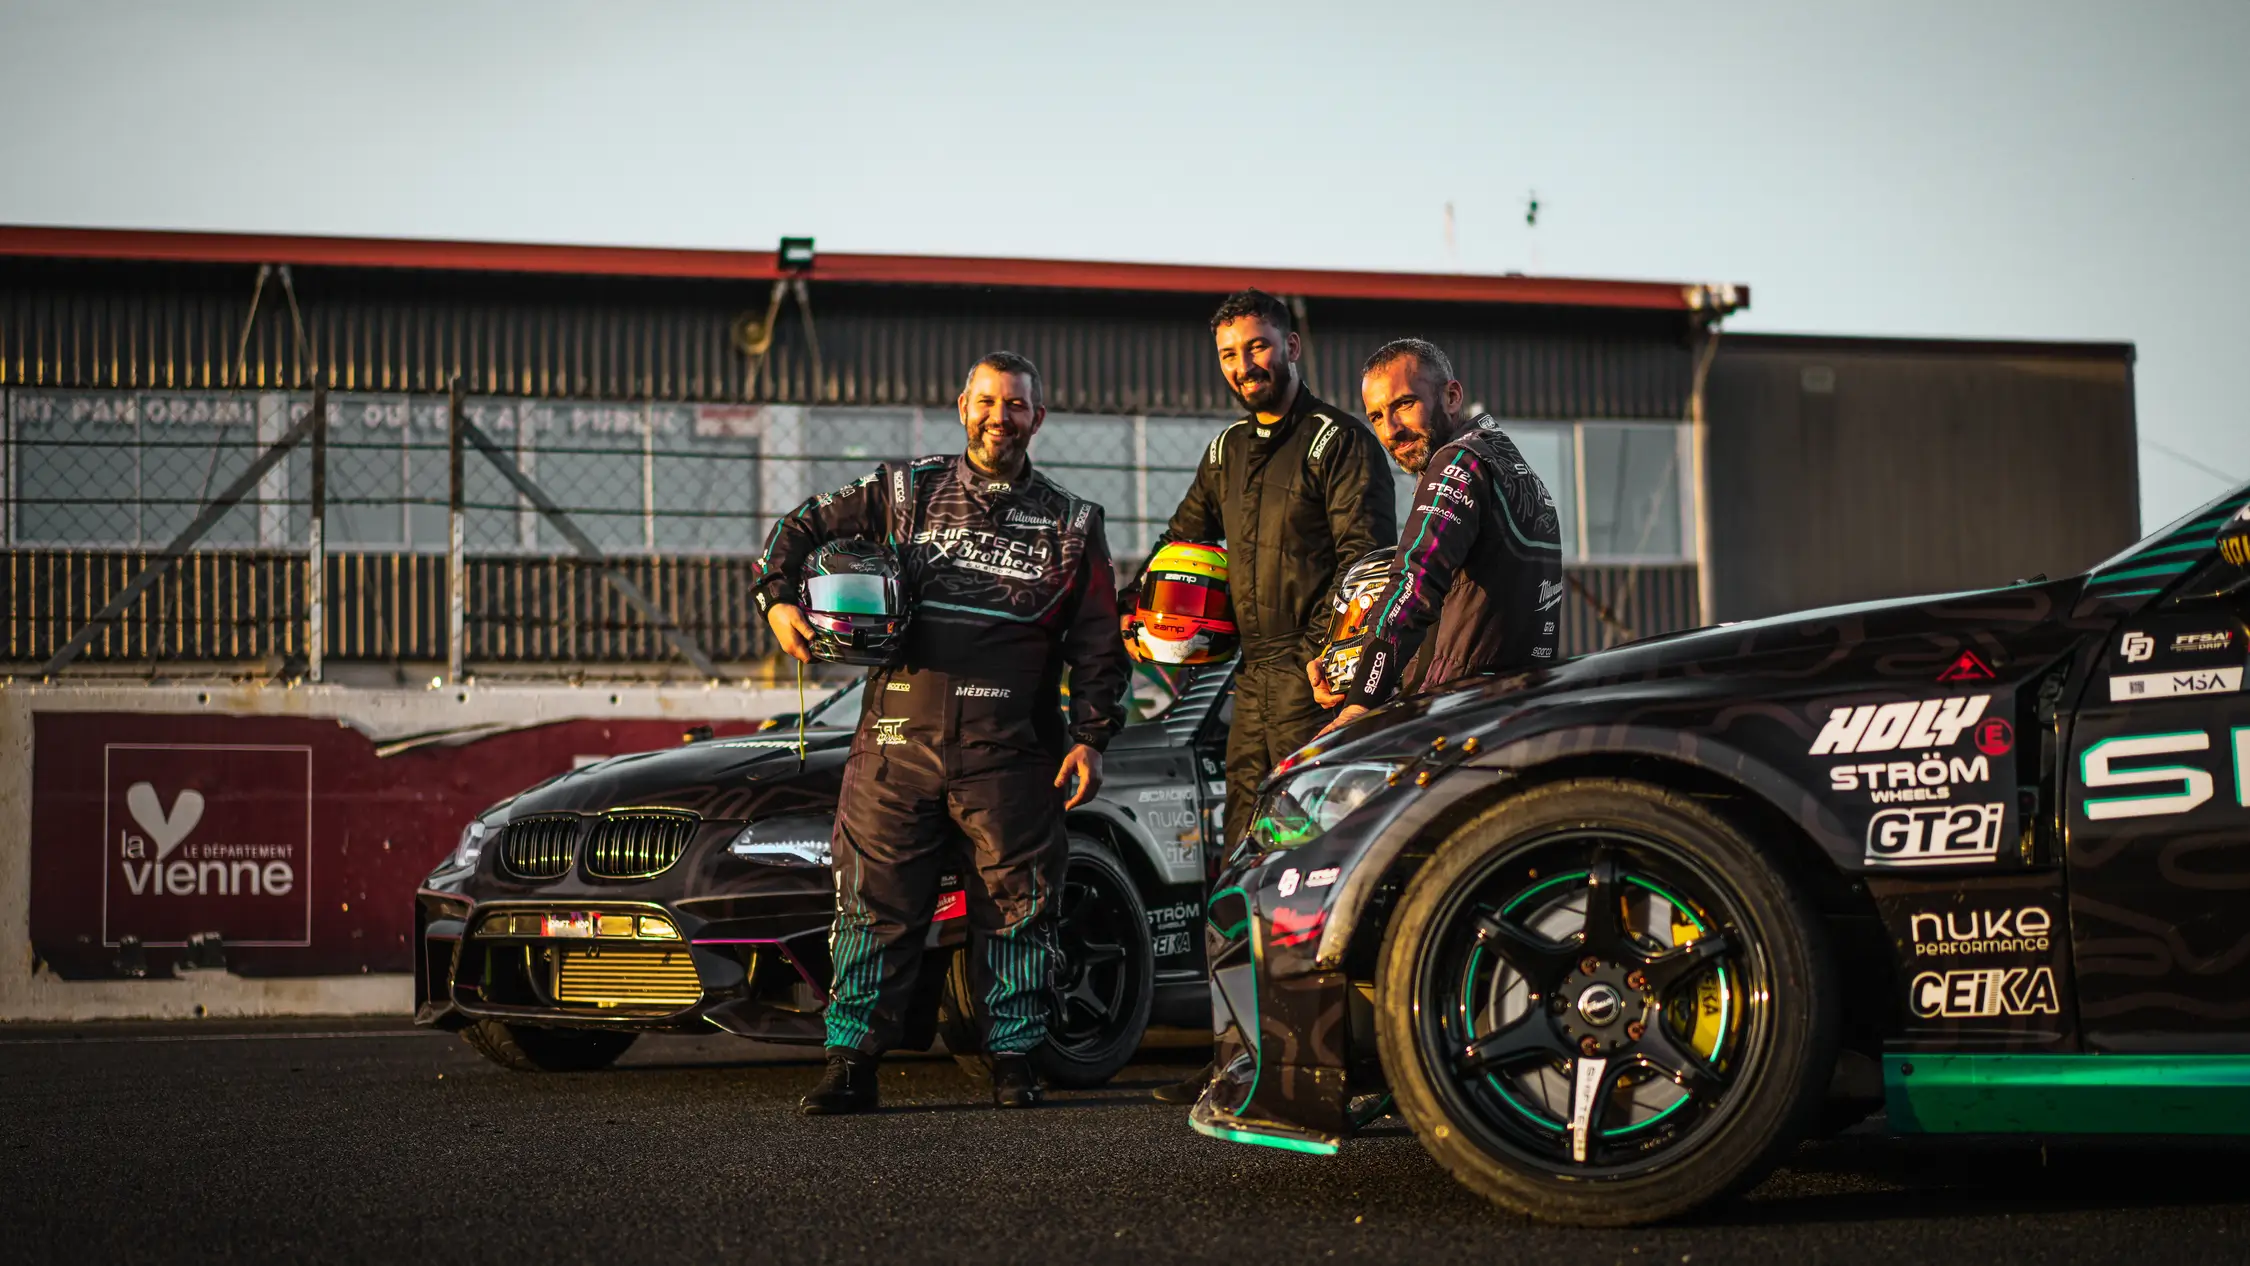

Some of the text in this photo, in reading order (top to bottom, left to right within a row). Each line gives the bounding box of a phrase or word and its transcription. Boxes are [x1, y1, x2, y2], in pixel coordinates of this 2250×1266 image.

[1312, 425, 1339, 460] sparco
[893, 470, 906, 503] sparco
[1074, 503, 1092, 530] sparco
[955, 539, 1044, 580] Brothers
[1164, 572, 1197, 584] zamp
[1154, 623, 1186, 634] zamp
[1364, 651, 1386, 696] sparco
[1808, 694, 1992, 756] HOLY
[1829, 751, 1989, 791] STRÖM
[1871, 786, 1950, 804] WHEELS
[1149, 808, 1197, 828] nuke
[1866, 802, 2004, 857] GT2i
[121, 828, 146, 858] la
[184, 842, 293, 858] LE DÉPARTEMENT
[121, 859, 294, 896] vienne
[1911, 906, 2052, 943] nuke
